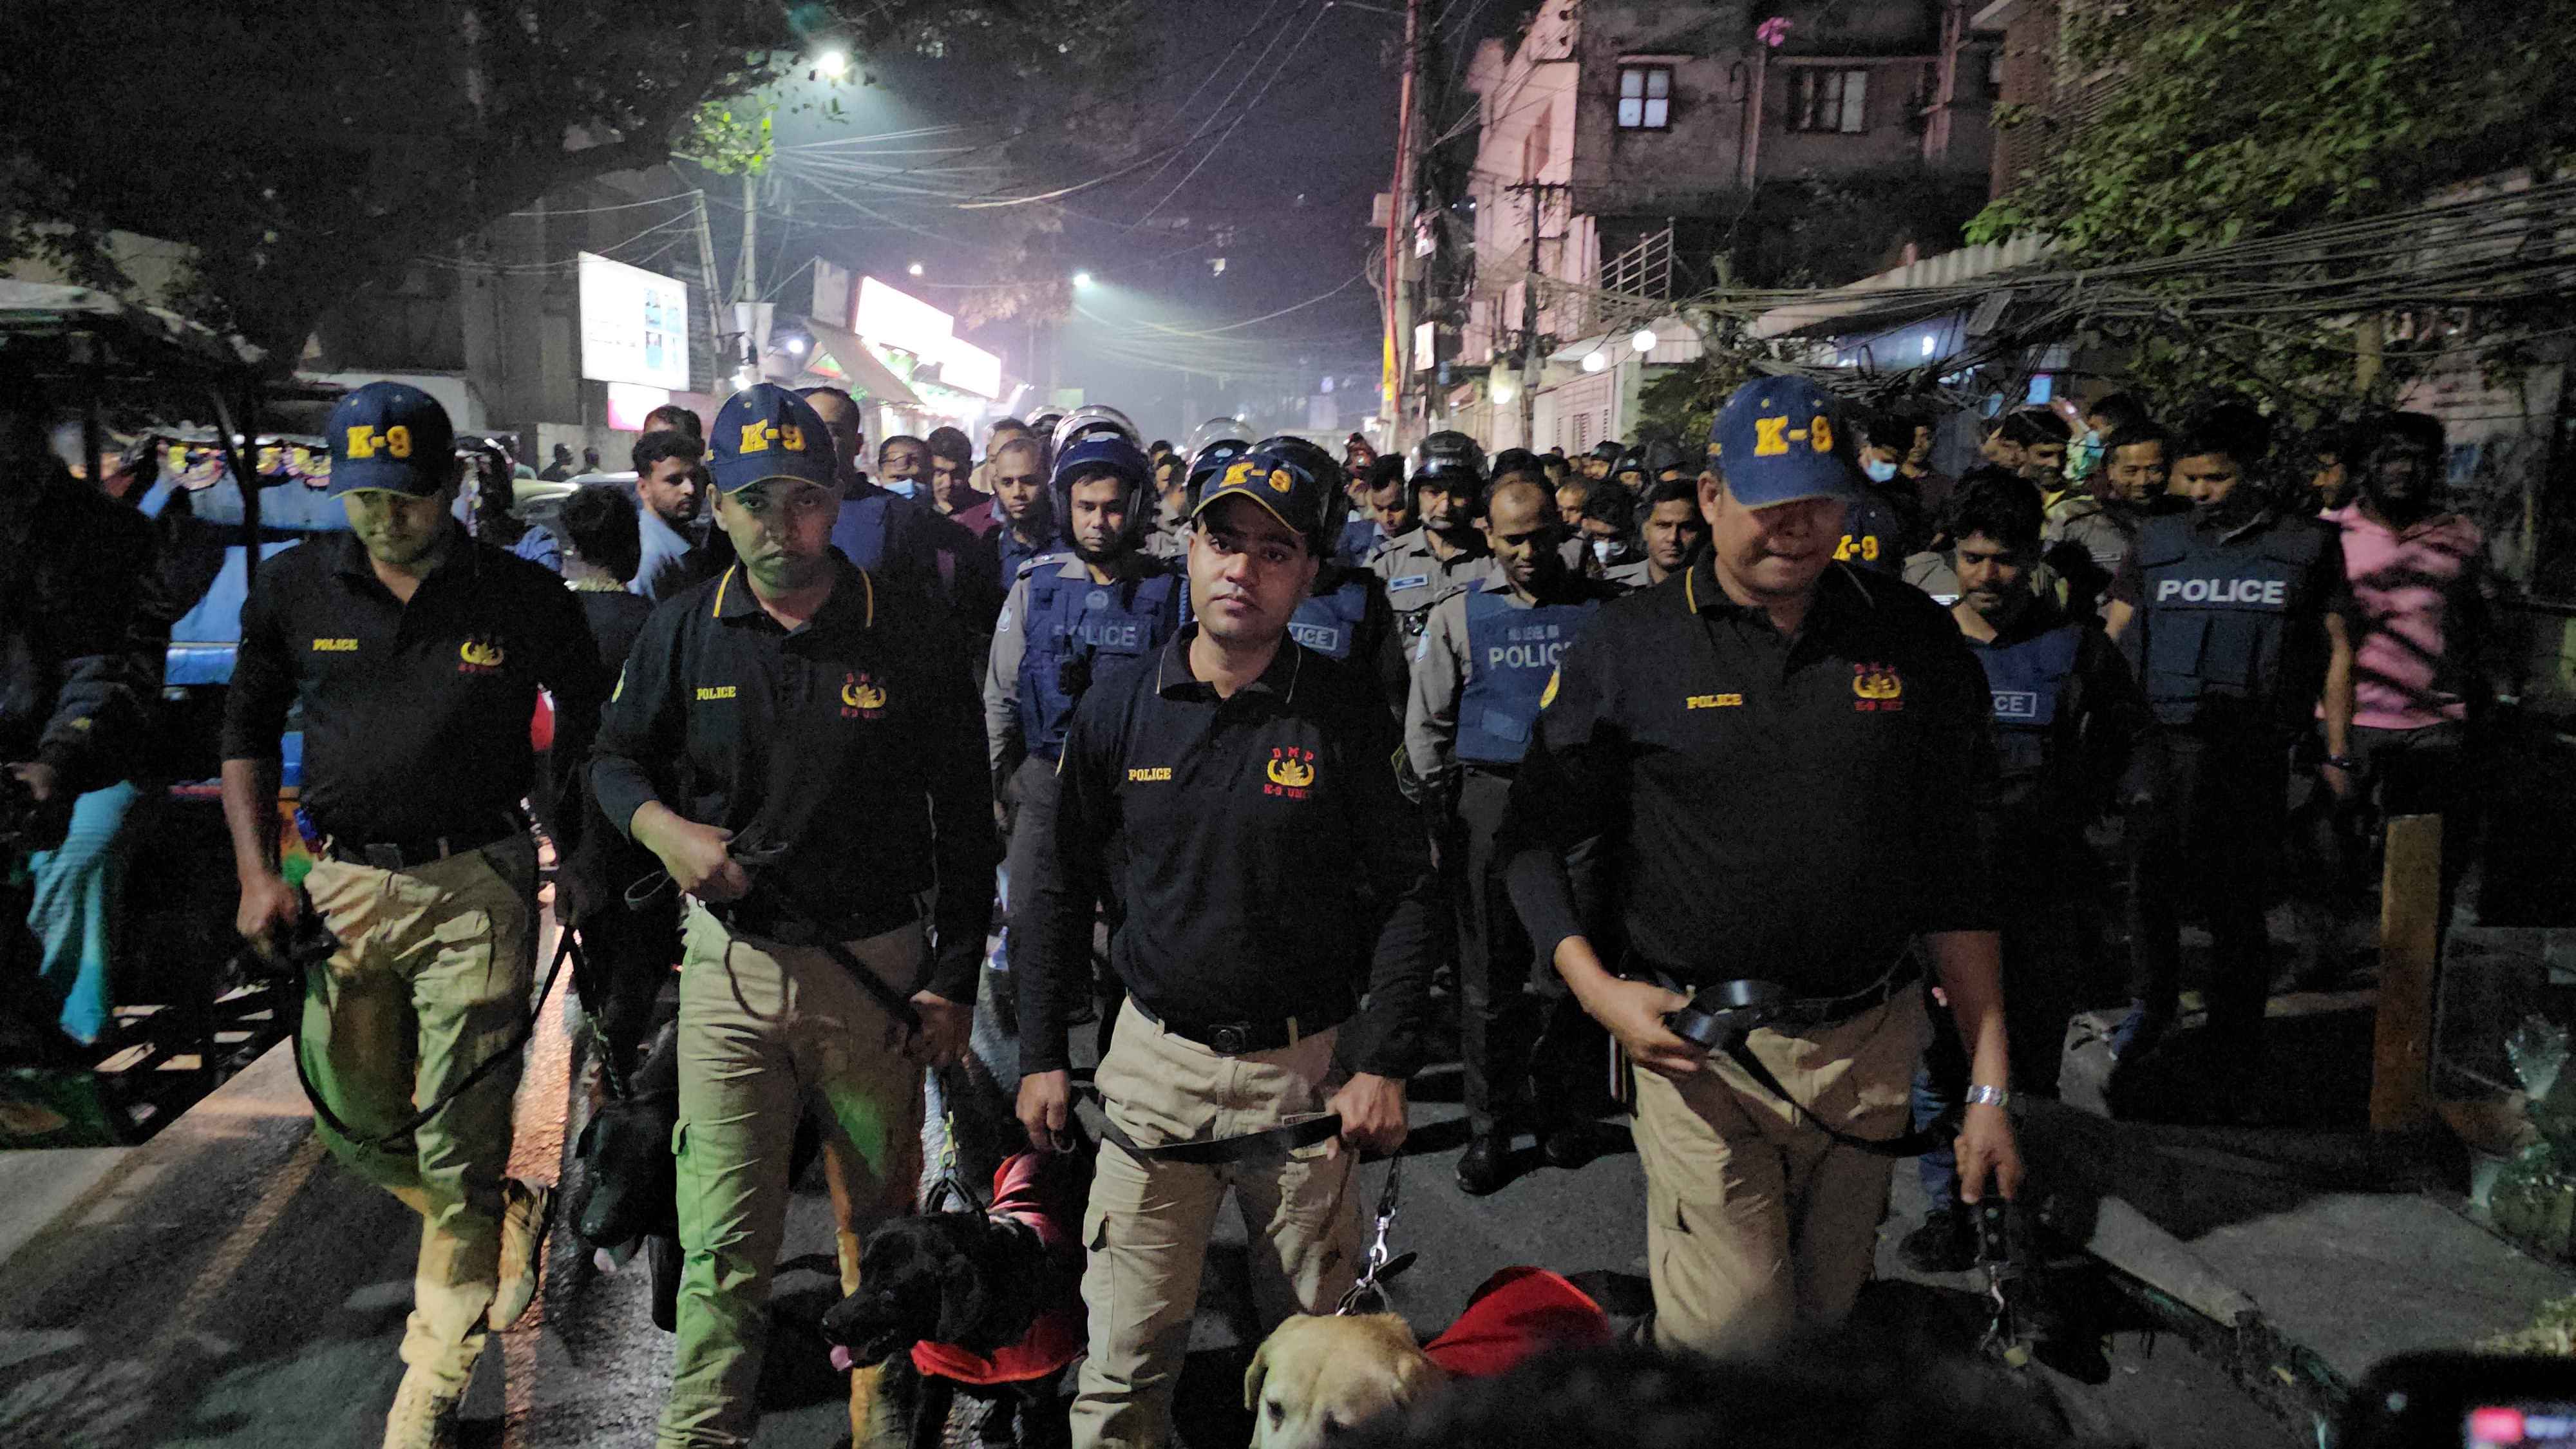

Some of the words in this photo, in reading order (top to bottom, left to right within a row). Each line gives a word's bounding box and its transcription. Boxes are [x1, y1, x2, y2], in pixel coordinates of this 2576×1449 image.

[346, 424, 412, 459] K-9
[739, 418, 806, 453] K-9
[1754, 414, 1835, 457] K-9
[1218, 461, 1293, 493] K-9
[2157, 579, 2287, 604] POLICE
[1488, 641, 1572, 670] POLIC
[696, 685, 737, 701] POLICE
[1685, 693, 1743, 710] POLICE
[1127, 766, 1173, 782] POLICE
